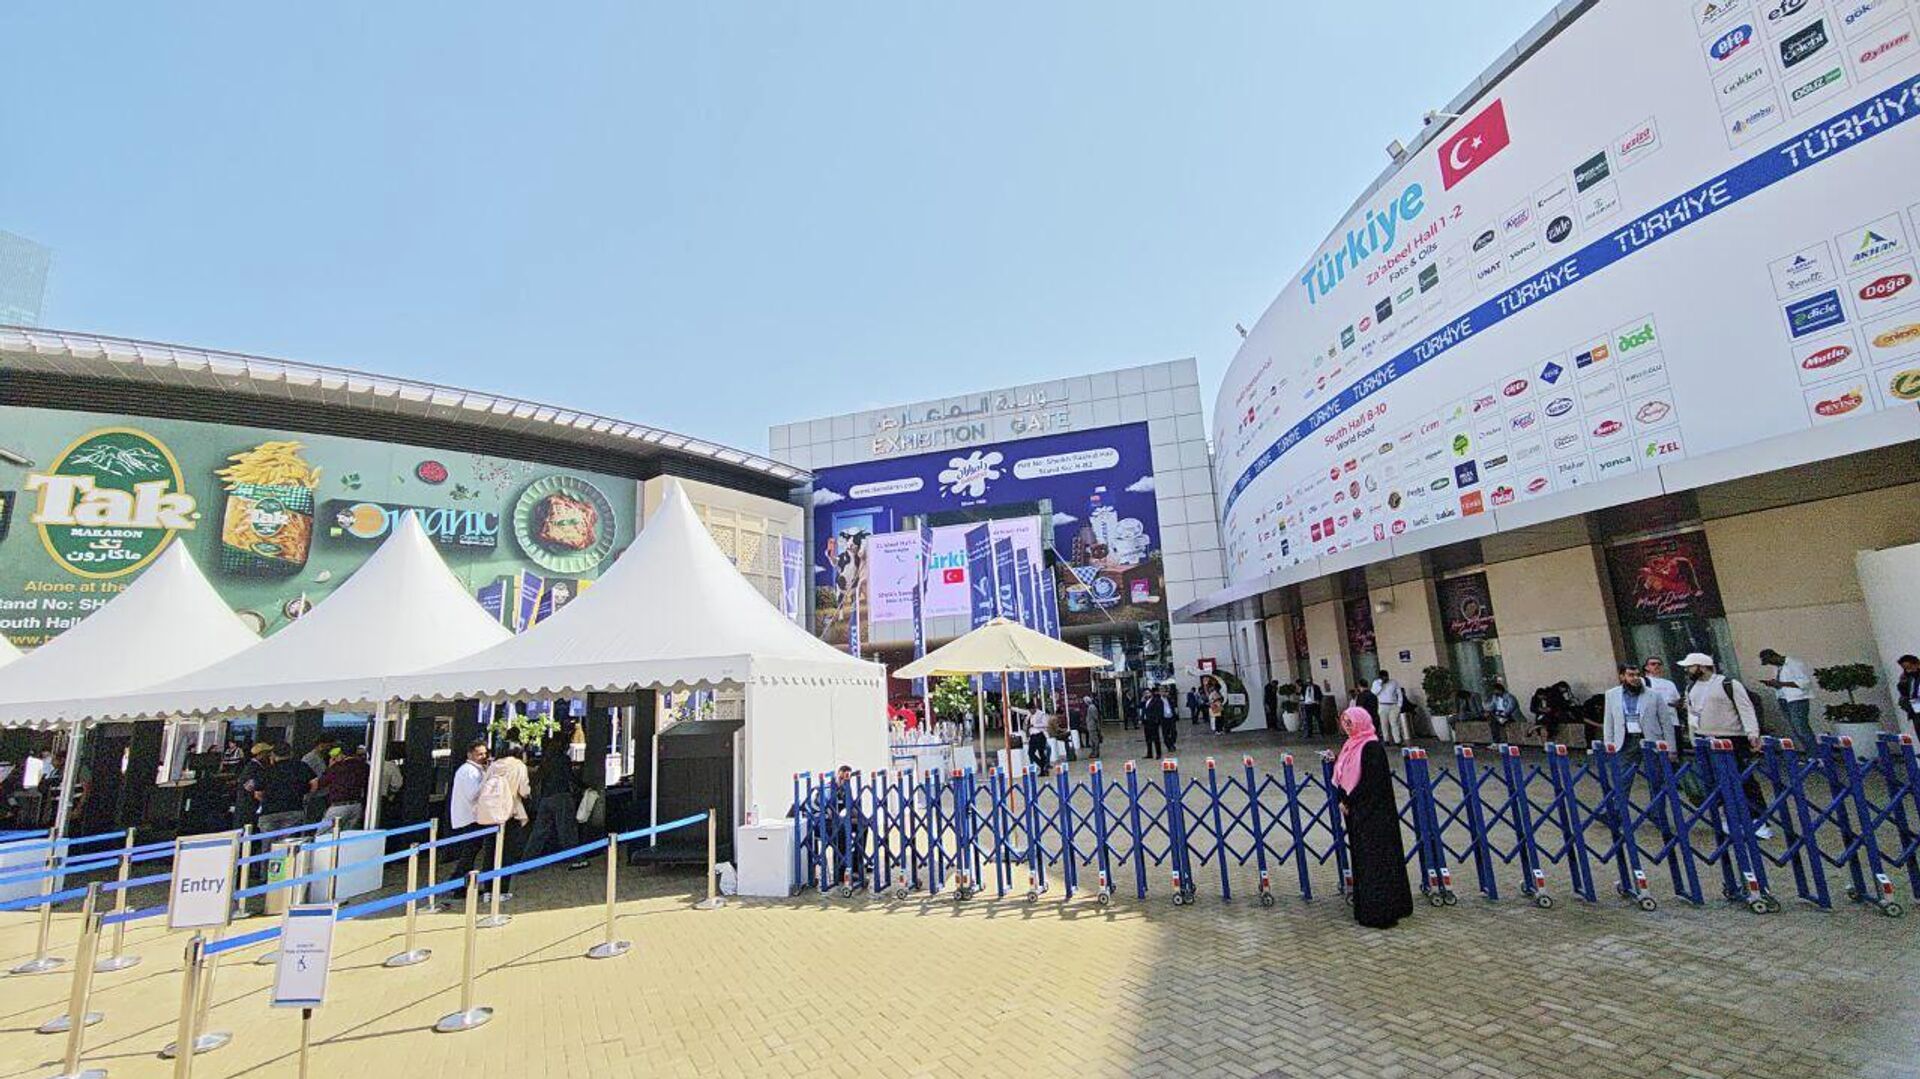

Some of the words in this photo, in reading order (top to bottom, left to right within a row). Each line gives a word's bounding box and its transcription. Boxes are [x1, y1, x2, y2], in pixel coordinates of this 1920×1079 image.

[1613, 179, 1732, 253] TÜRKİYE
[1301, 183, 1424, 305] Türkiye
[1366, 243, 1413, 286] Za'abeel
[1413, 220, 1438, 246] Hall
[1853, 240, 1898, 262] AKHAN
[1389, 265, 1409, 283] Fats
[1410, 257, 1417, 268] &
[1418, 242, 1438, 260] Oils
[1496, 259, 1579, 316] TÜRKİYE
[1866, 276, 1907, 297] Doğa
[1807, 302, 1838, 320] dicle
[1412, 317, 1473, 364] TÜRKİYE
[1618, 324, 1655, 352] dost
[1805, 347, 1846, 368] Mutlu
[1352, 362, 1397, 400] TÜRKİYE
[873, 422, 986, 456] EXHIBITION
[1011, 410, 1070, 434] GATE
[1324, 428, 1348, 446] South
[1348, 413, 1366, 433] Hall
[1336, 434, 1357, 451] World
[1357, 424, 1376, 441] Food
[1659, 441, 1680, 455] ZEL
[1599, 456, 1632, 470] yonca
[24, 472, 197, 529] Tak
[71, 528, 143, 539] MAKARON
[25, 580, 75, 592] Alone
[80, 582, 96, 592] at
[42, 598, 73, 610] No:
[181, 877, 224, 894] Entry
